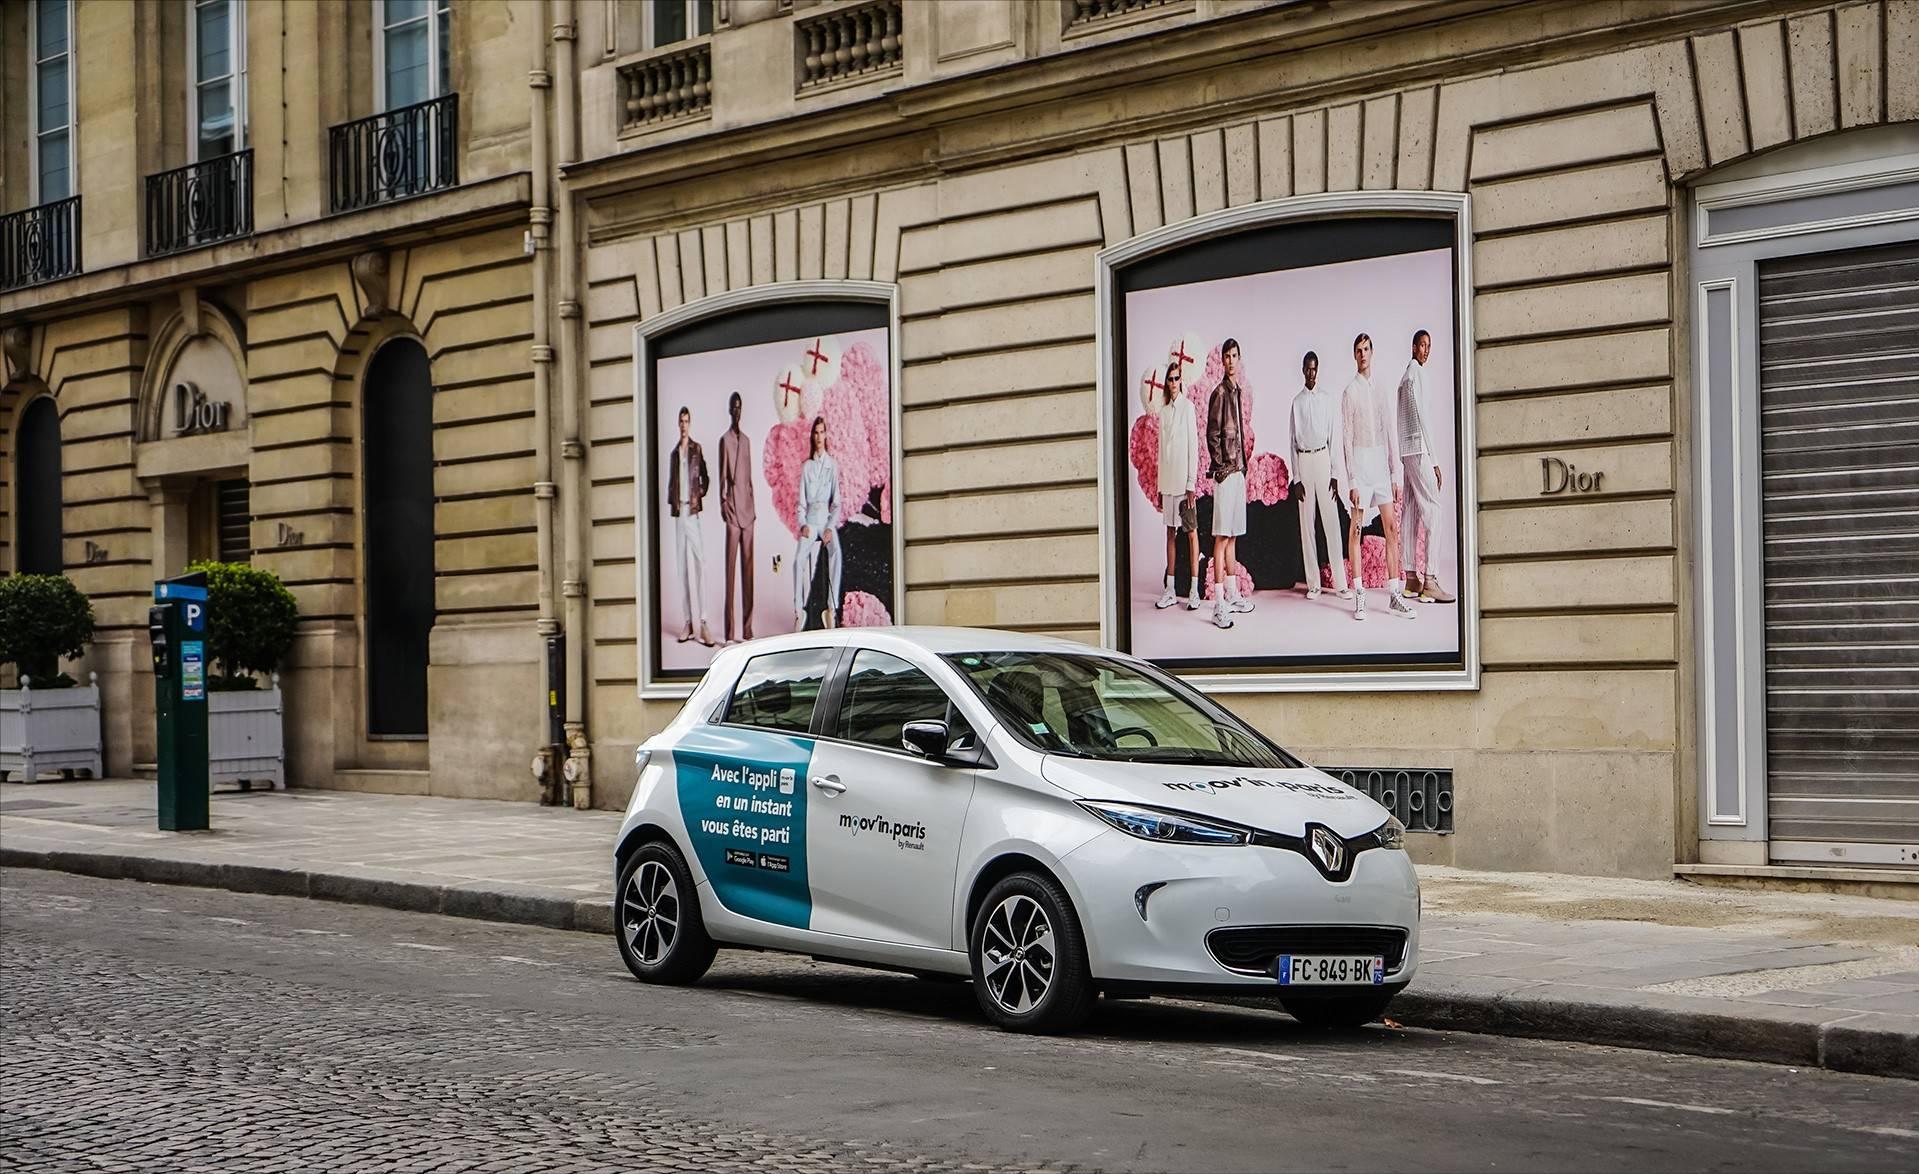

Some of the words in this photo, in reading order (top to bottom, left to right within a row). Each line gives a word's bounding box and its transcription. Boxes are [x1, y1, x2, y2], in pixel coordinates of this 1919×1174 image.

[173, 382, 230, 436] Dior
[1539, 457, 1605, 495] Dior
[277, 522, 304, 546] Dior
[187, 604, 201, 626] P
[711, 763, 740, 784] Avec
[742, 765, 777, 791] l'appli
[716, 795, 731, 809] en
[733, 797, 749, 811] un
[751, 794, 792, 817] instant
[702, 819, 730, 835] vous
[732, 819, 758, 839] êtes
[760, 826, 790, 846] parti
[898, 839, 905, 850] by
[905, 840, 925, 851] Renault
[1292, 958, 1372, 981] FC-849-BK
[1374, 970, 1382, 982] 75
